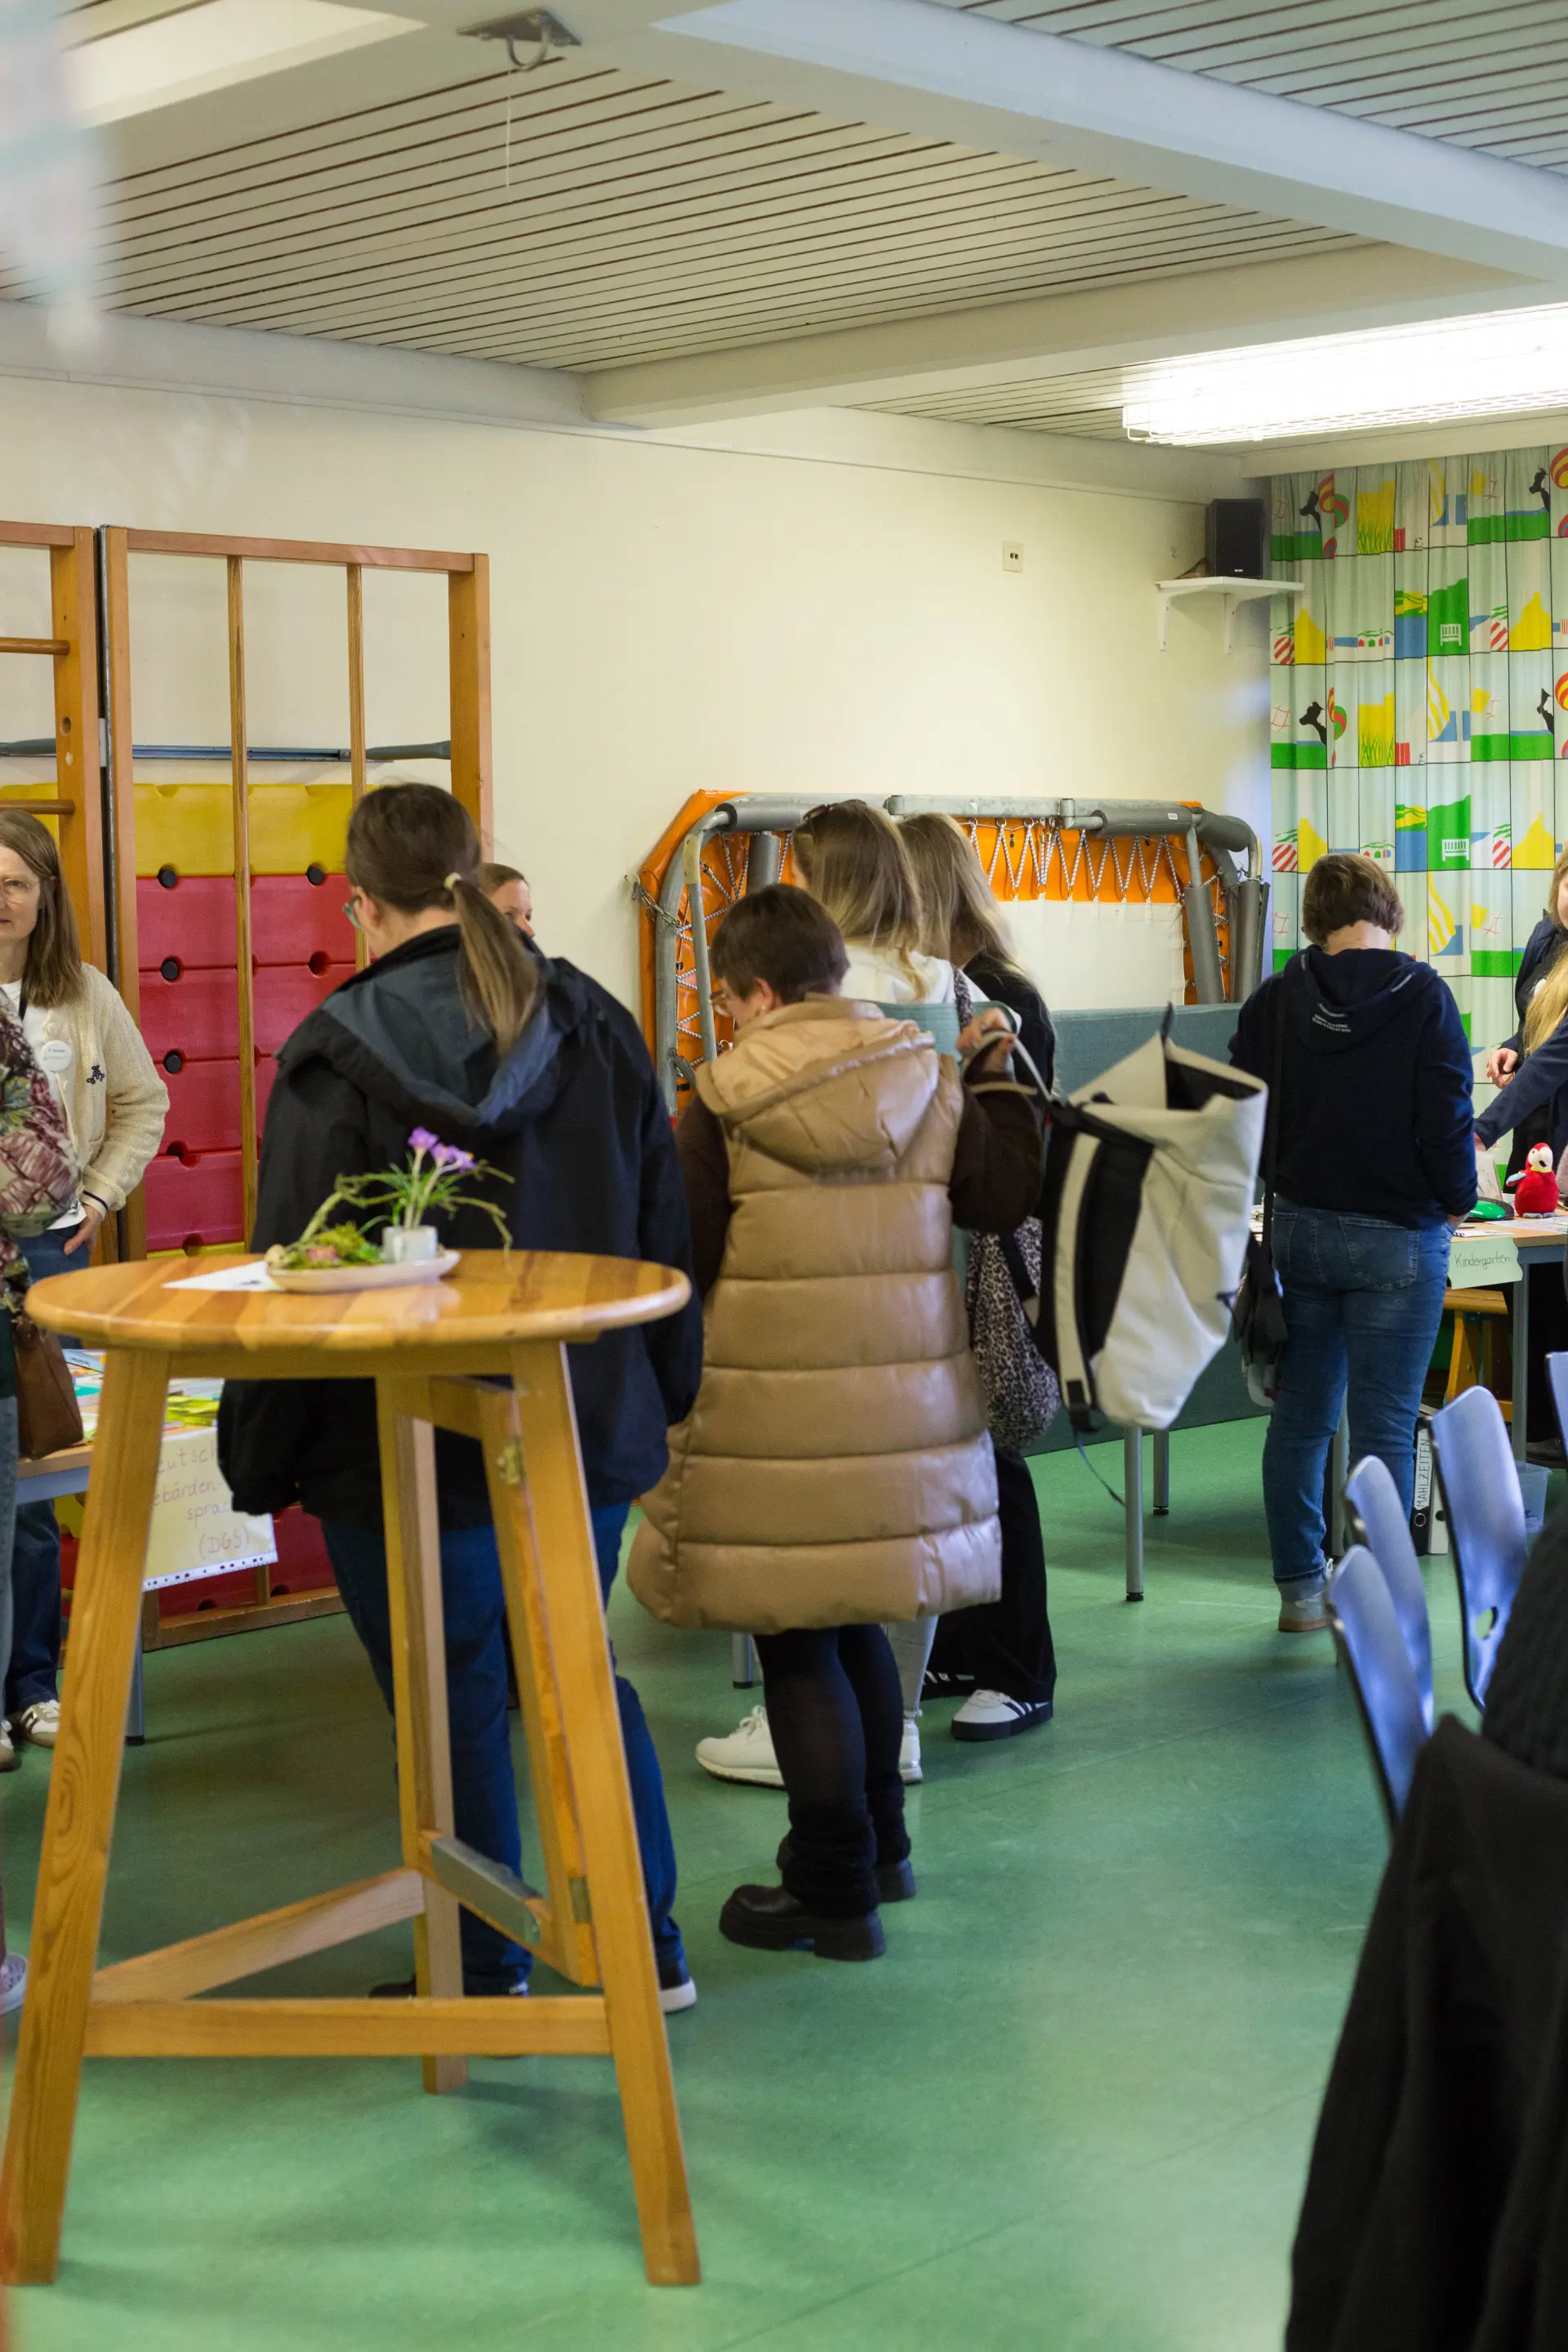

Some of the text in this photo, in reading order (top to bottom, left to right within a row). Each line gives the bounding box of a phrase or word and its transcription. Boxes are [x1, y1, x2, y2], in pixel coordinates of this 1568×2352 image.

[1454, 1250, 1511, 1270] Kindergarten
[1417, 1438, 1432, 1508] MAHLZEITEN
[198, 1524, 250, 1560] (DGS)
